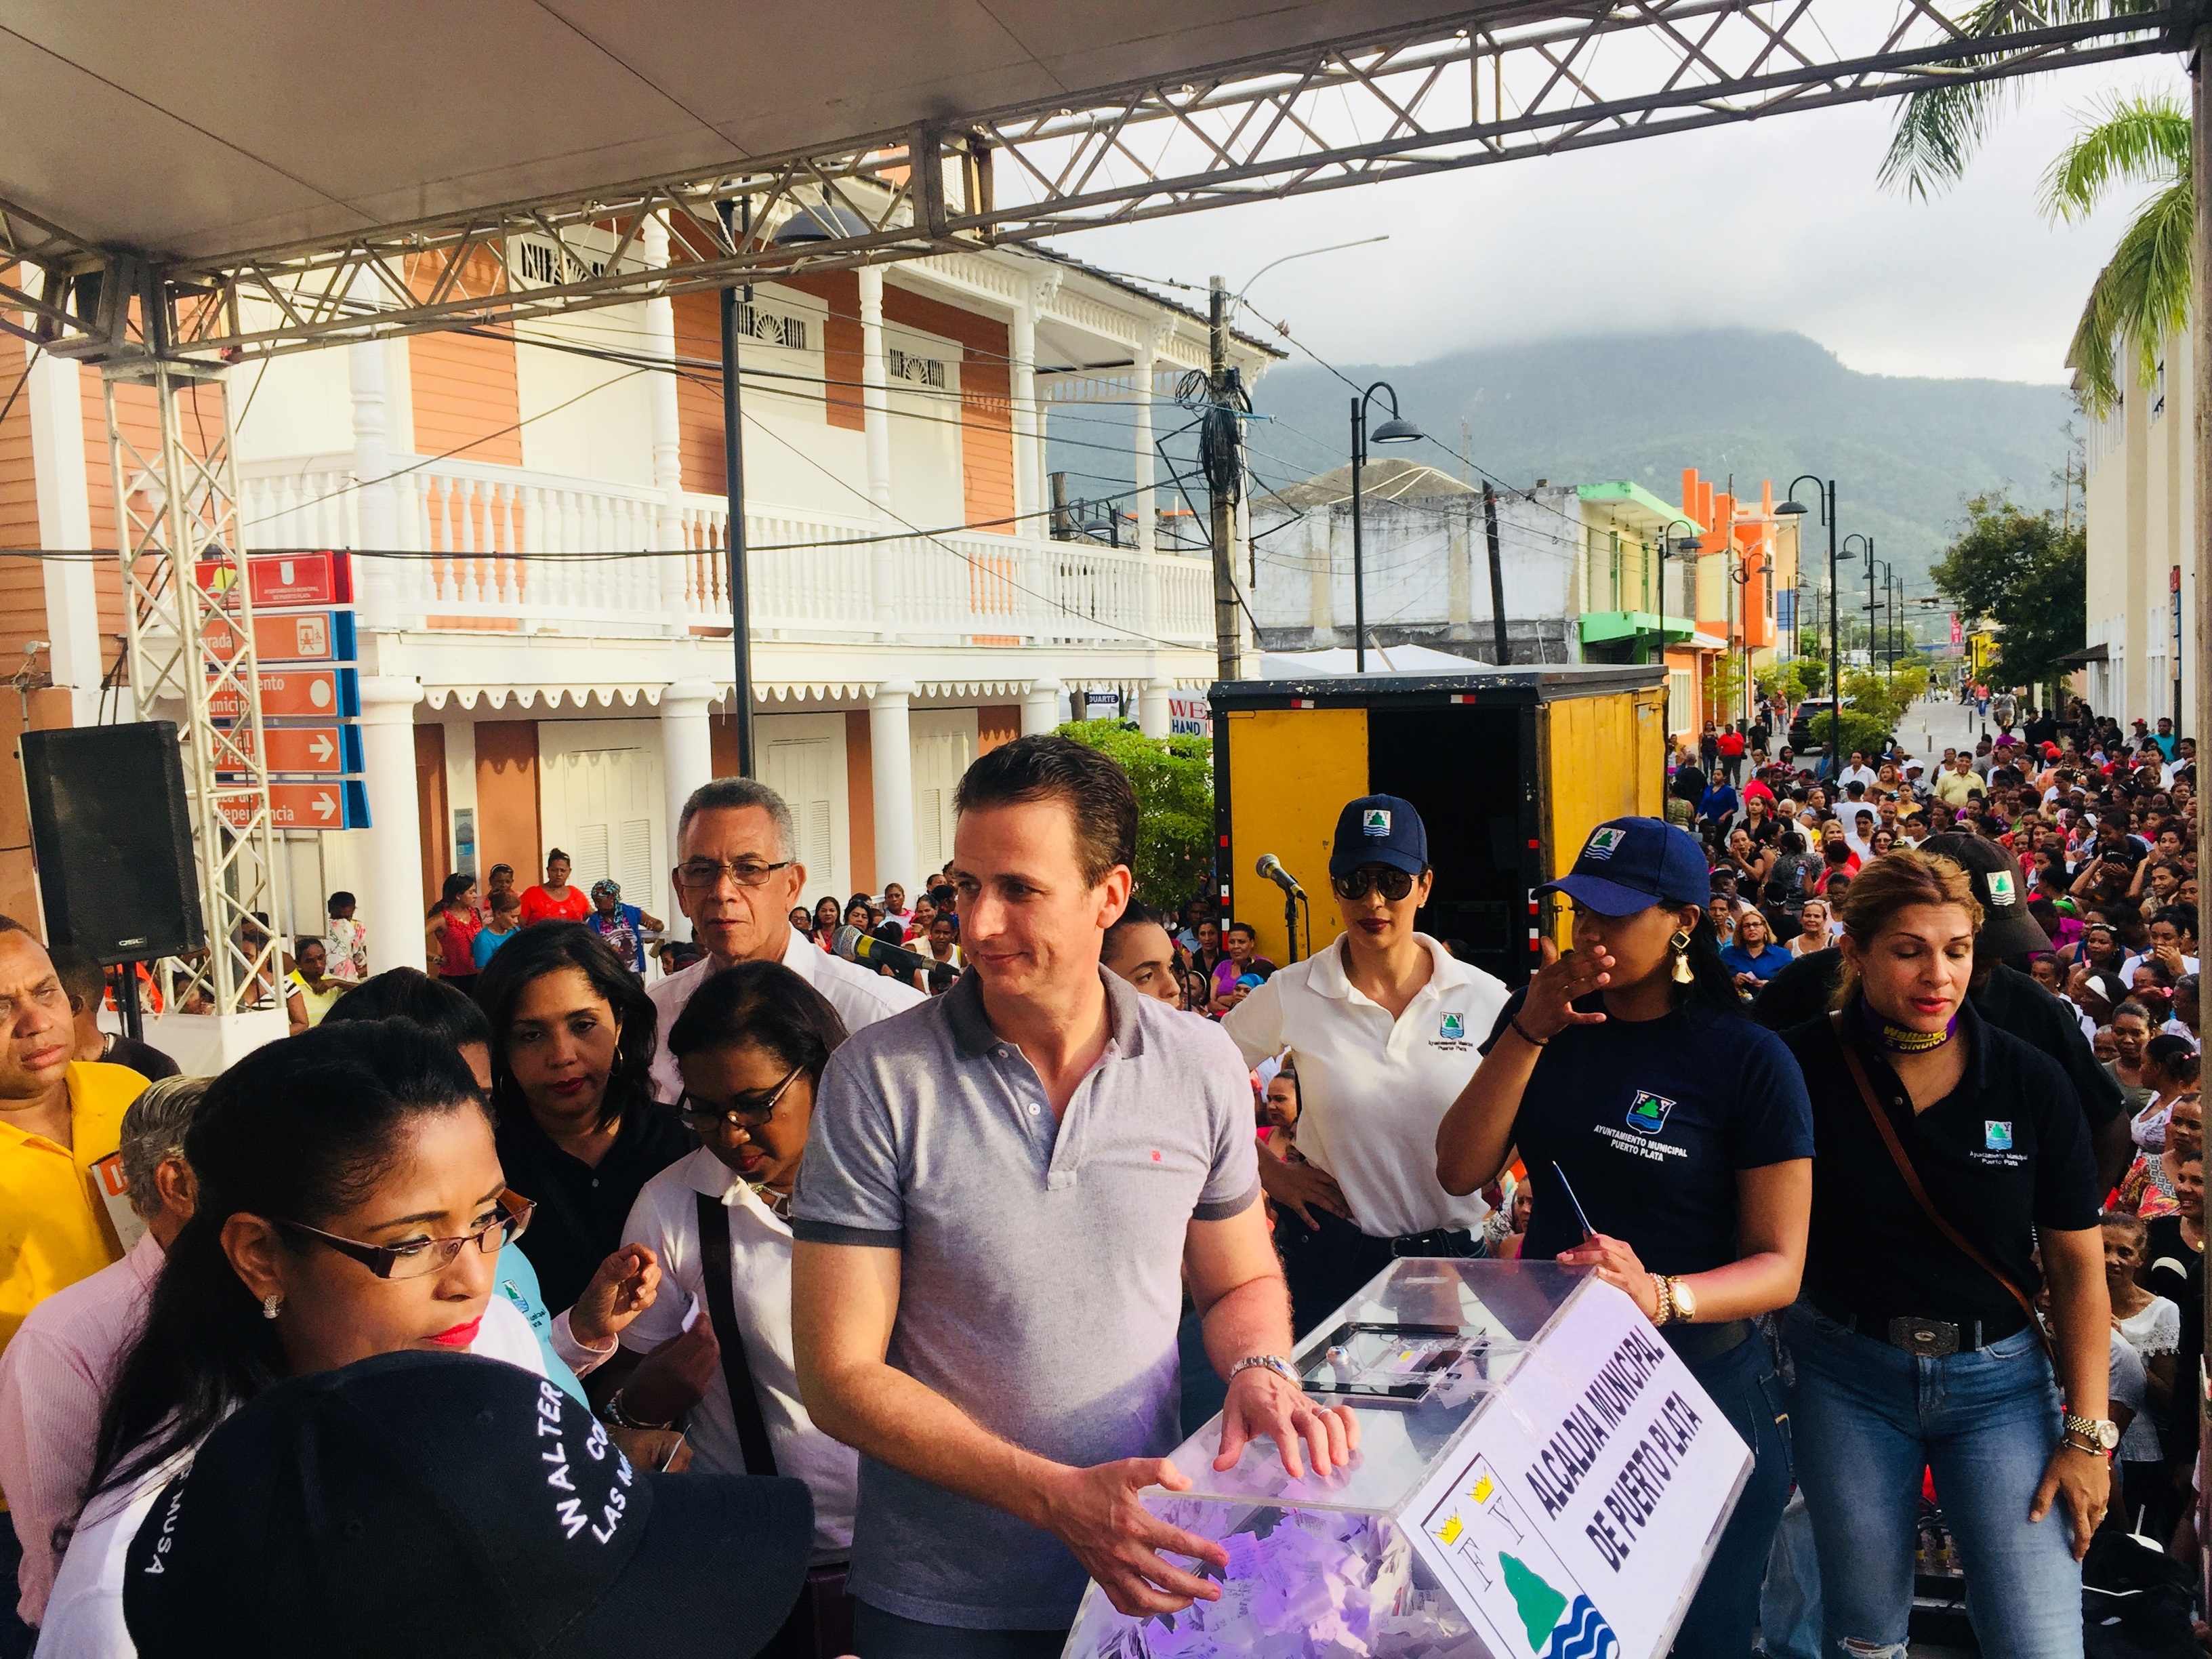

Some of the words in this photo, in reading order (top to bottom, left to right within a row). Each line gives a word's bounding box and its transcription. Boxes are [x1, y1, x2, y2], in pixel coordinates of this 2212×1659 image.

[1172, 719, 1200, 735] HAND
[119, 938, 144, 946] QSC
[1593, 1124, 1646, 1147] AYUNTAMIENTO
[1647, 1140, 1687, 1158] MUNICIPAL
[1610, 1139, 1639, 1154] PUERTO
[1640, 1147, 1664, 1162] PLATA
[1525, 1402, 1610, 1521] ALCALDIA
[1584, 1325, 1665, 1431] MUNICIPAL
[1648, 1390, 1703, 1467] PLATA
[537, 1380, 588, 1540] WALTER
[1603, 1439, 1672, 1542] PUERTO
[592, 1487, 626, 1544] LAS
[1584, 1509, 1631, 1574] DE
